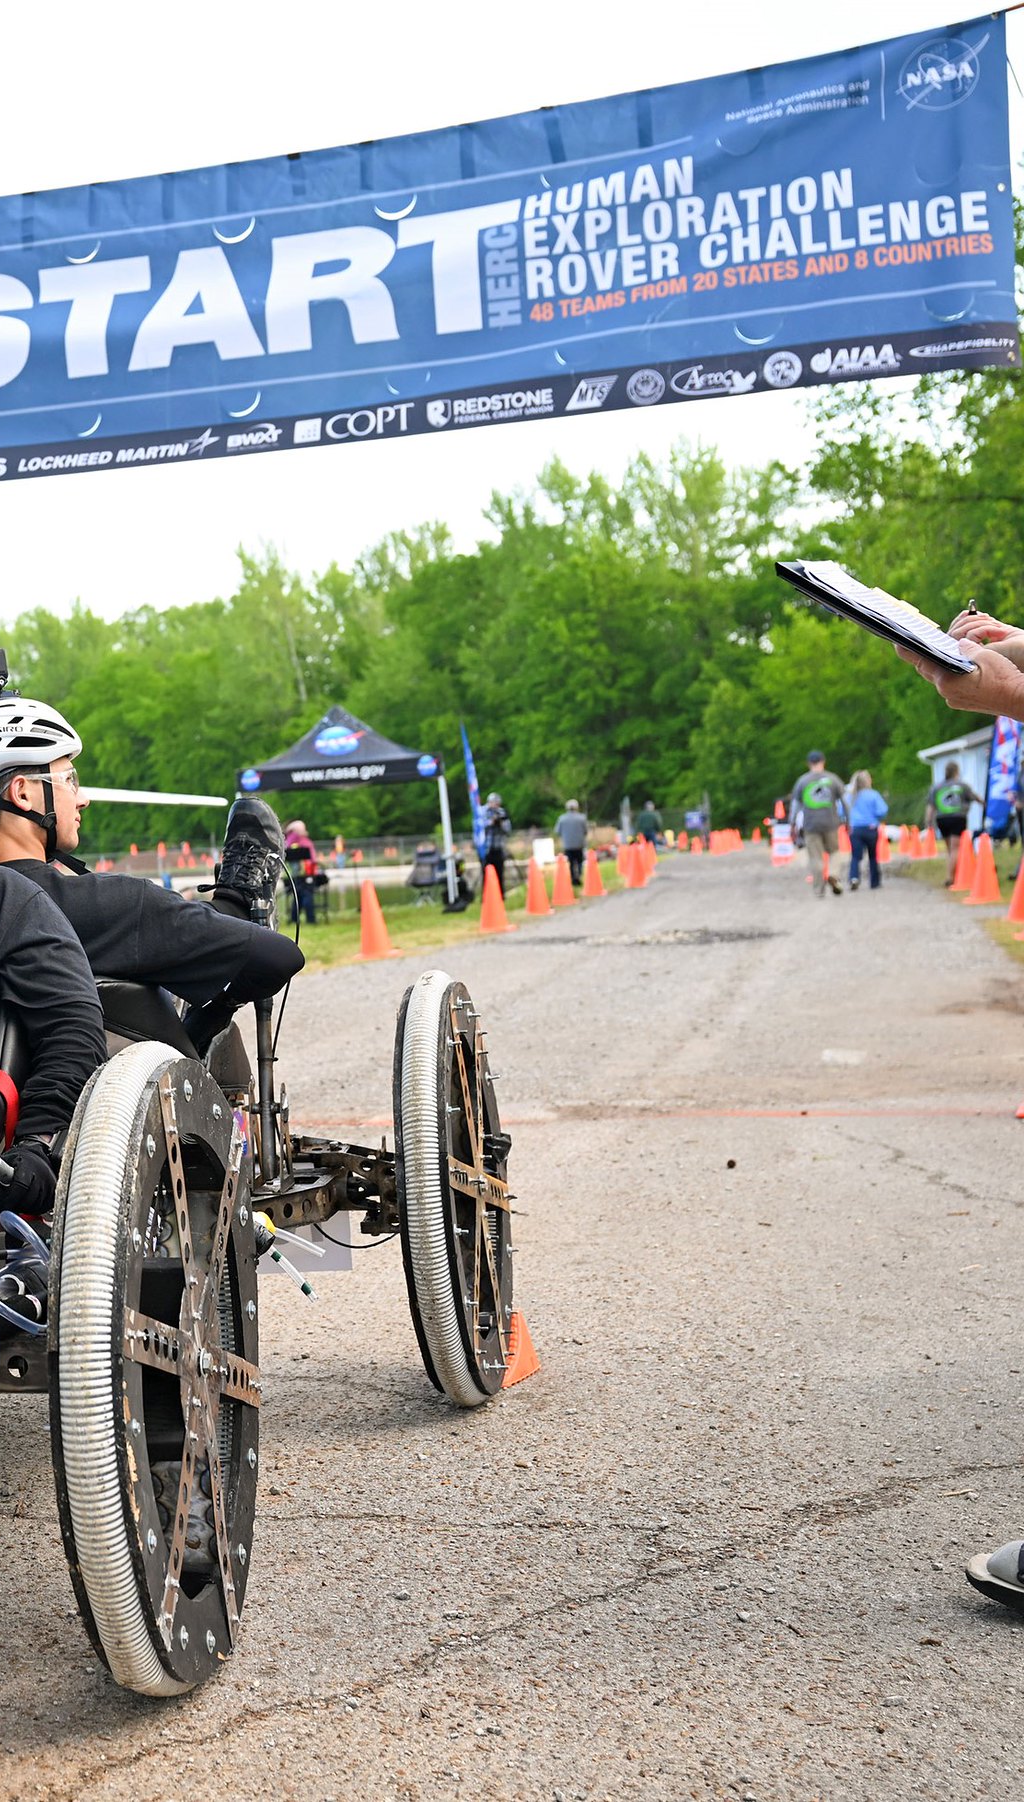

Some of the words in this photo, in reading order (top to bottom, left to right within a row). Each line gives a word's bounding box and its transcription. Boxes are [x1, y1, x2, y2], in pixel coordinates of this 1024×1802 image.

[905, 61, 975, 89] NASA
[725, 102, 774, 122] National
[775, 83, 846, 107] Aeronautics
[848, 79, 870, 92] and
[746, 107, 784, 124] Space
[784, 95, 870, 117] Administration
[523, 156, 694, 220] HUMAN
[523, 167, 855, 259] EXPLORATION
[525, 246, 680, 300] ROVER
[699, 190, 990, 269] CHALLENGE
[483, 222, 522, 328] HERC
[530, 302, 554, 322] 48
[559, 291, 626, 319] TEAMS
[631, 278, 688, 304] FROM
[693, 271, 719, 293] 20
[723, 260, 799, 289] STATES
[804, 253, 850, 276] AND
[854, 248, 869, 269] 8
[874, 233, 994, 268] COUNTRIES
[831, 344, 897, 371] AIAA
[453, 388, 554, 416] REDSTONE
[454, 411, 491, 424] FEDERAL
[492, 409, 523, 420] CREDIT
[525, 404, 554, 415] UNION
[325, 401, 415, 440] COPT
[17, 449, 113, 473] LOCKHEED
[115, 442, 189, 464] MARTIN
[290, 764, 387, 783] www.nasa.gov
